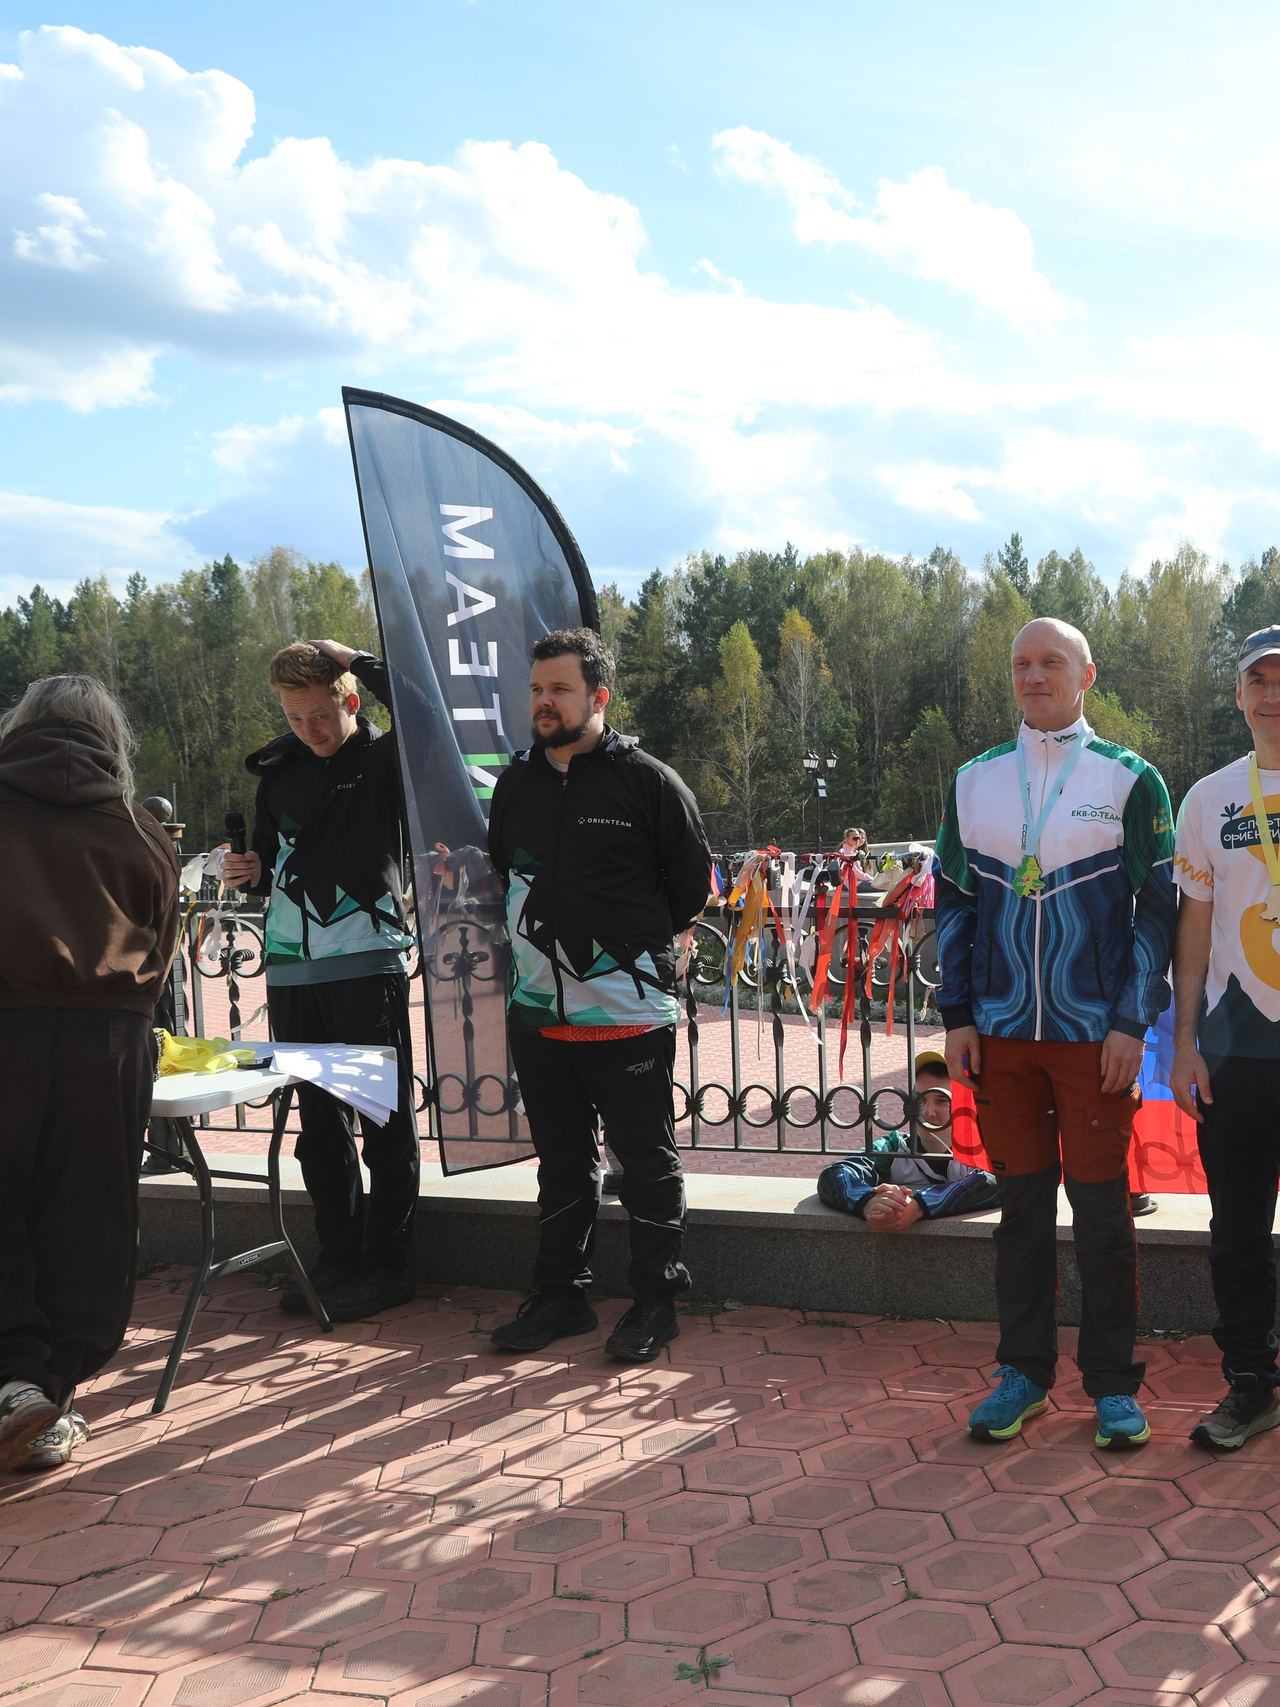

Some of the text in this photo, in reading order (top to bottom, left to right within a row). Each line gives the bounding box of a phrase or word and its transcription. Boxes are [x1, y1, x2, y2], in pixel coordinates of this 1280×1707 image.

[1071, 810, 1122, 822] EKB-O-TEAM
[587, 817, 632, 828] ORIENTEAM
[1020, 823, 1028, 851] CODE
